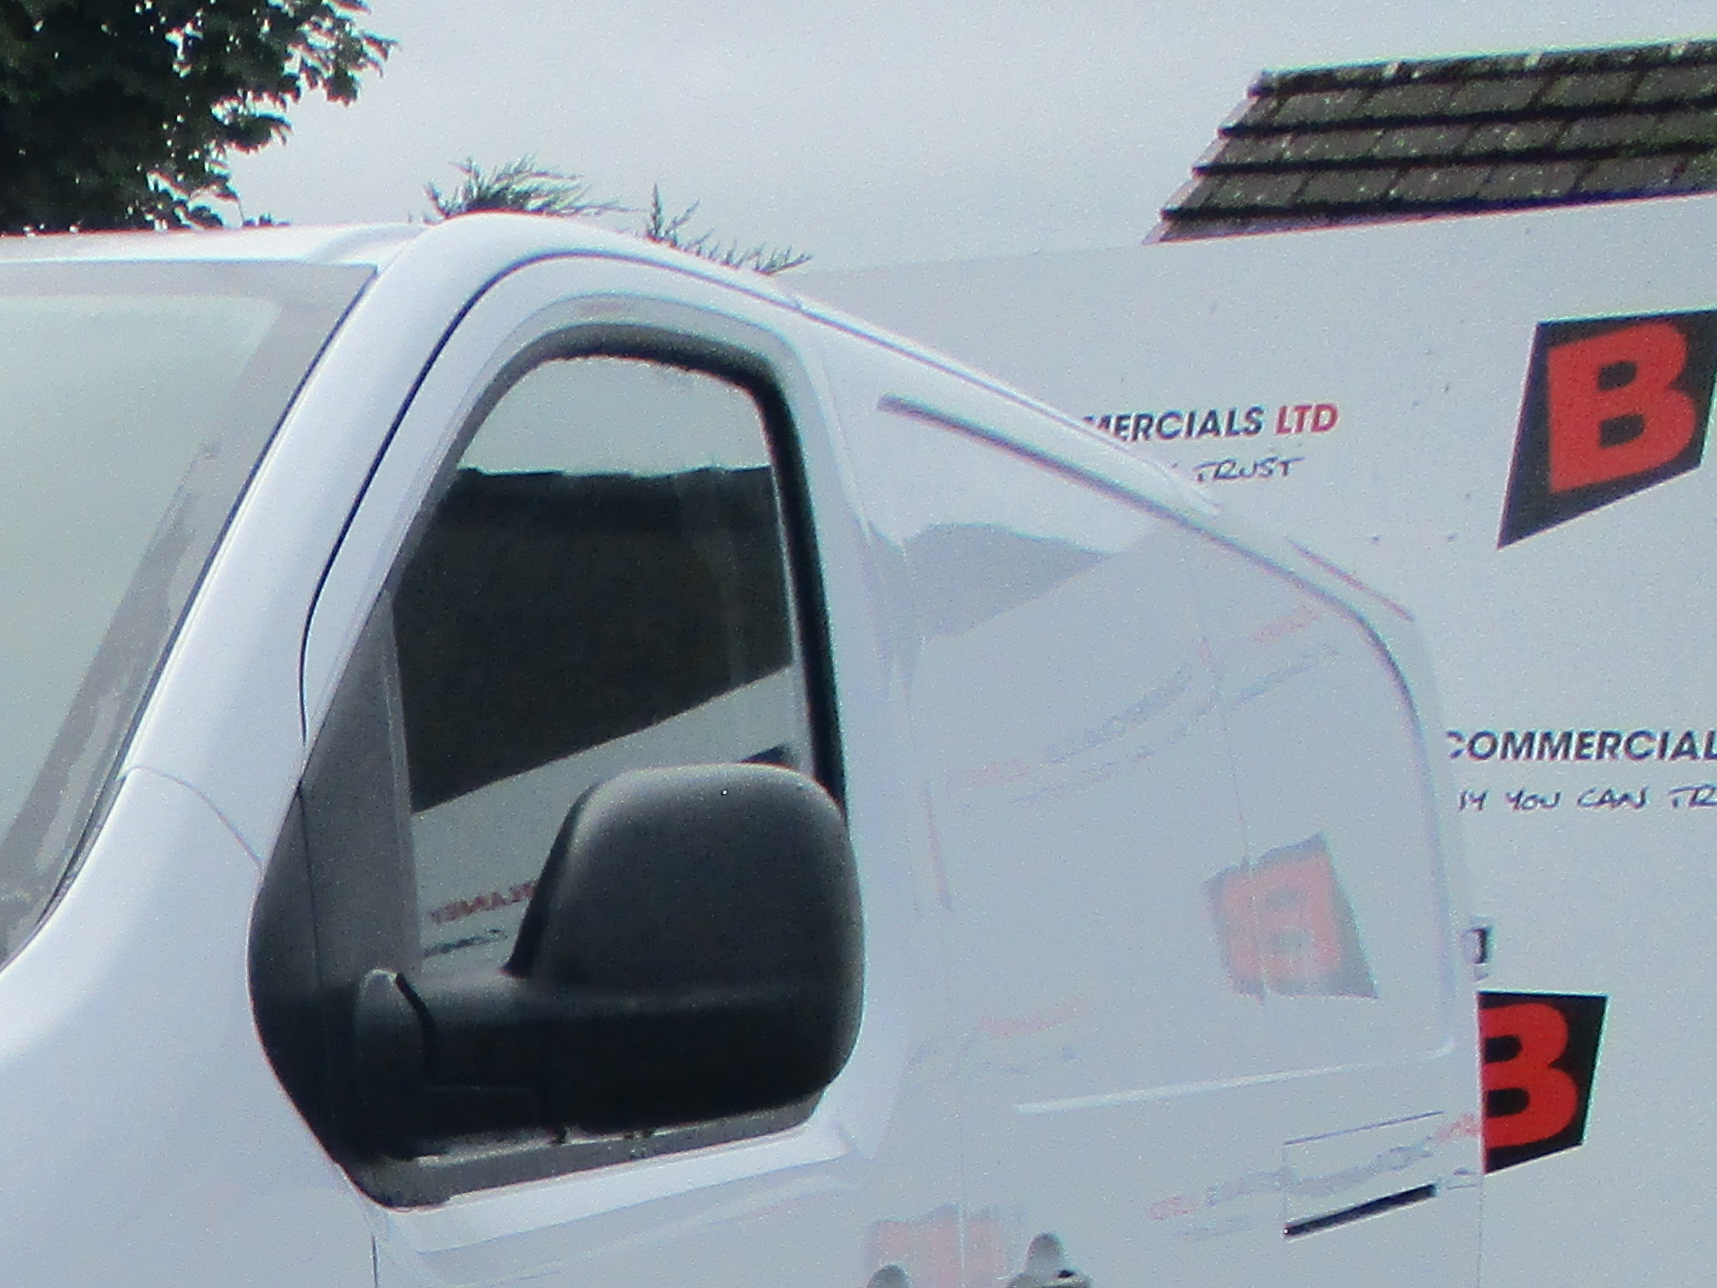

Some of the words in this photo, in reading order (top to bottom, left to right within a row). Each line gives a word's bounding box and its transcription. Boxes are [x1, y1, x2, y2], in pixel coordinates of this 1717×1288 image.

[1274, 403, 1339, 436] LTD
[1546, 322, 1698, 495] B
[1193, 455, 1305, 482] TRUST
[1504, 790, 1562, 811] YOU
[1576, 787, 1650, 810] CAN
